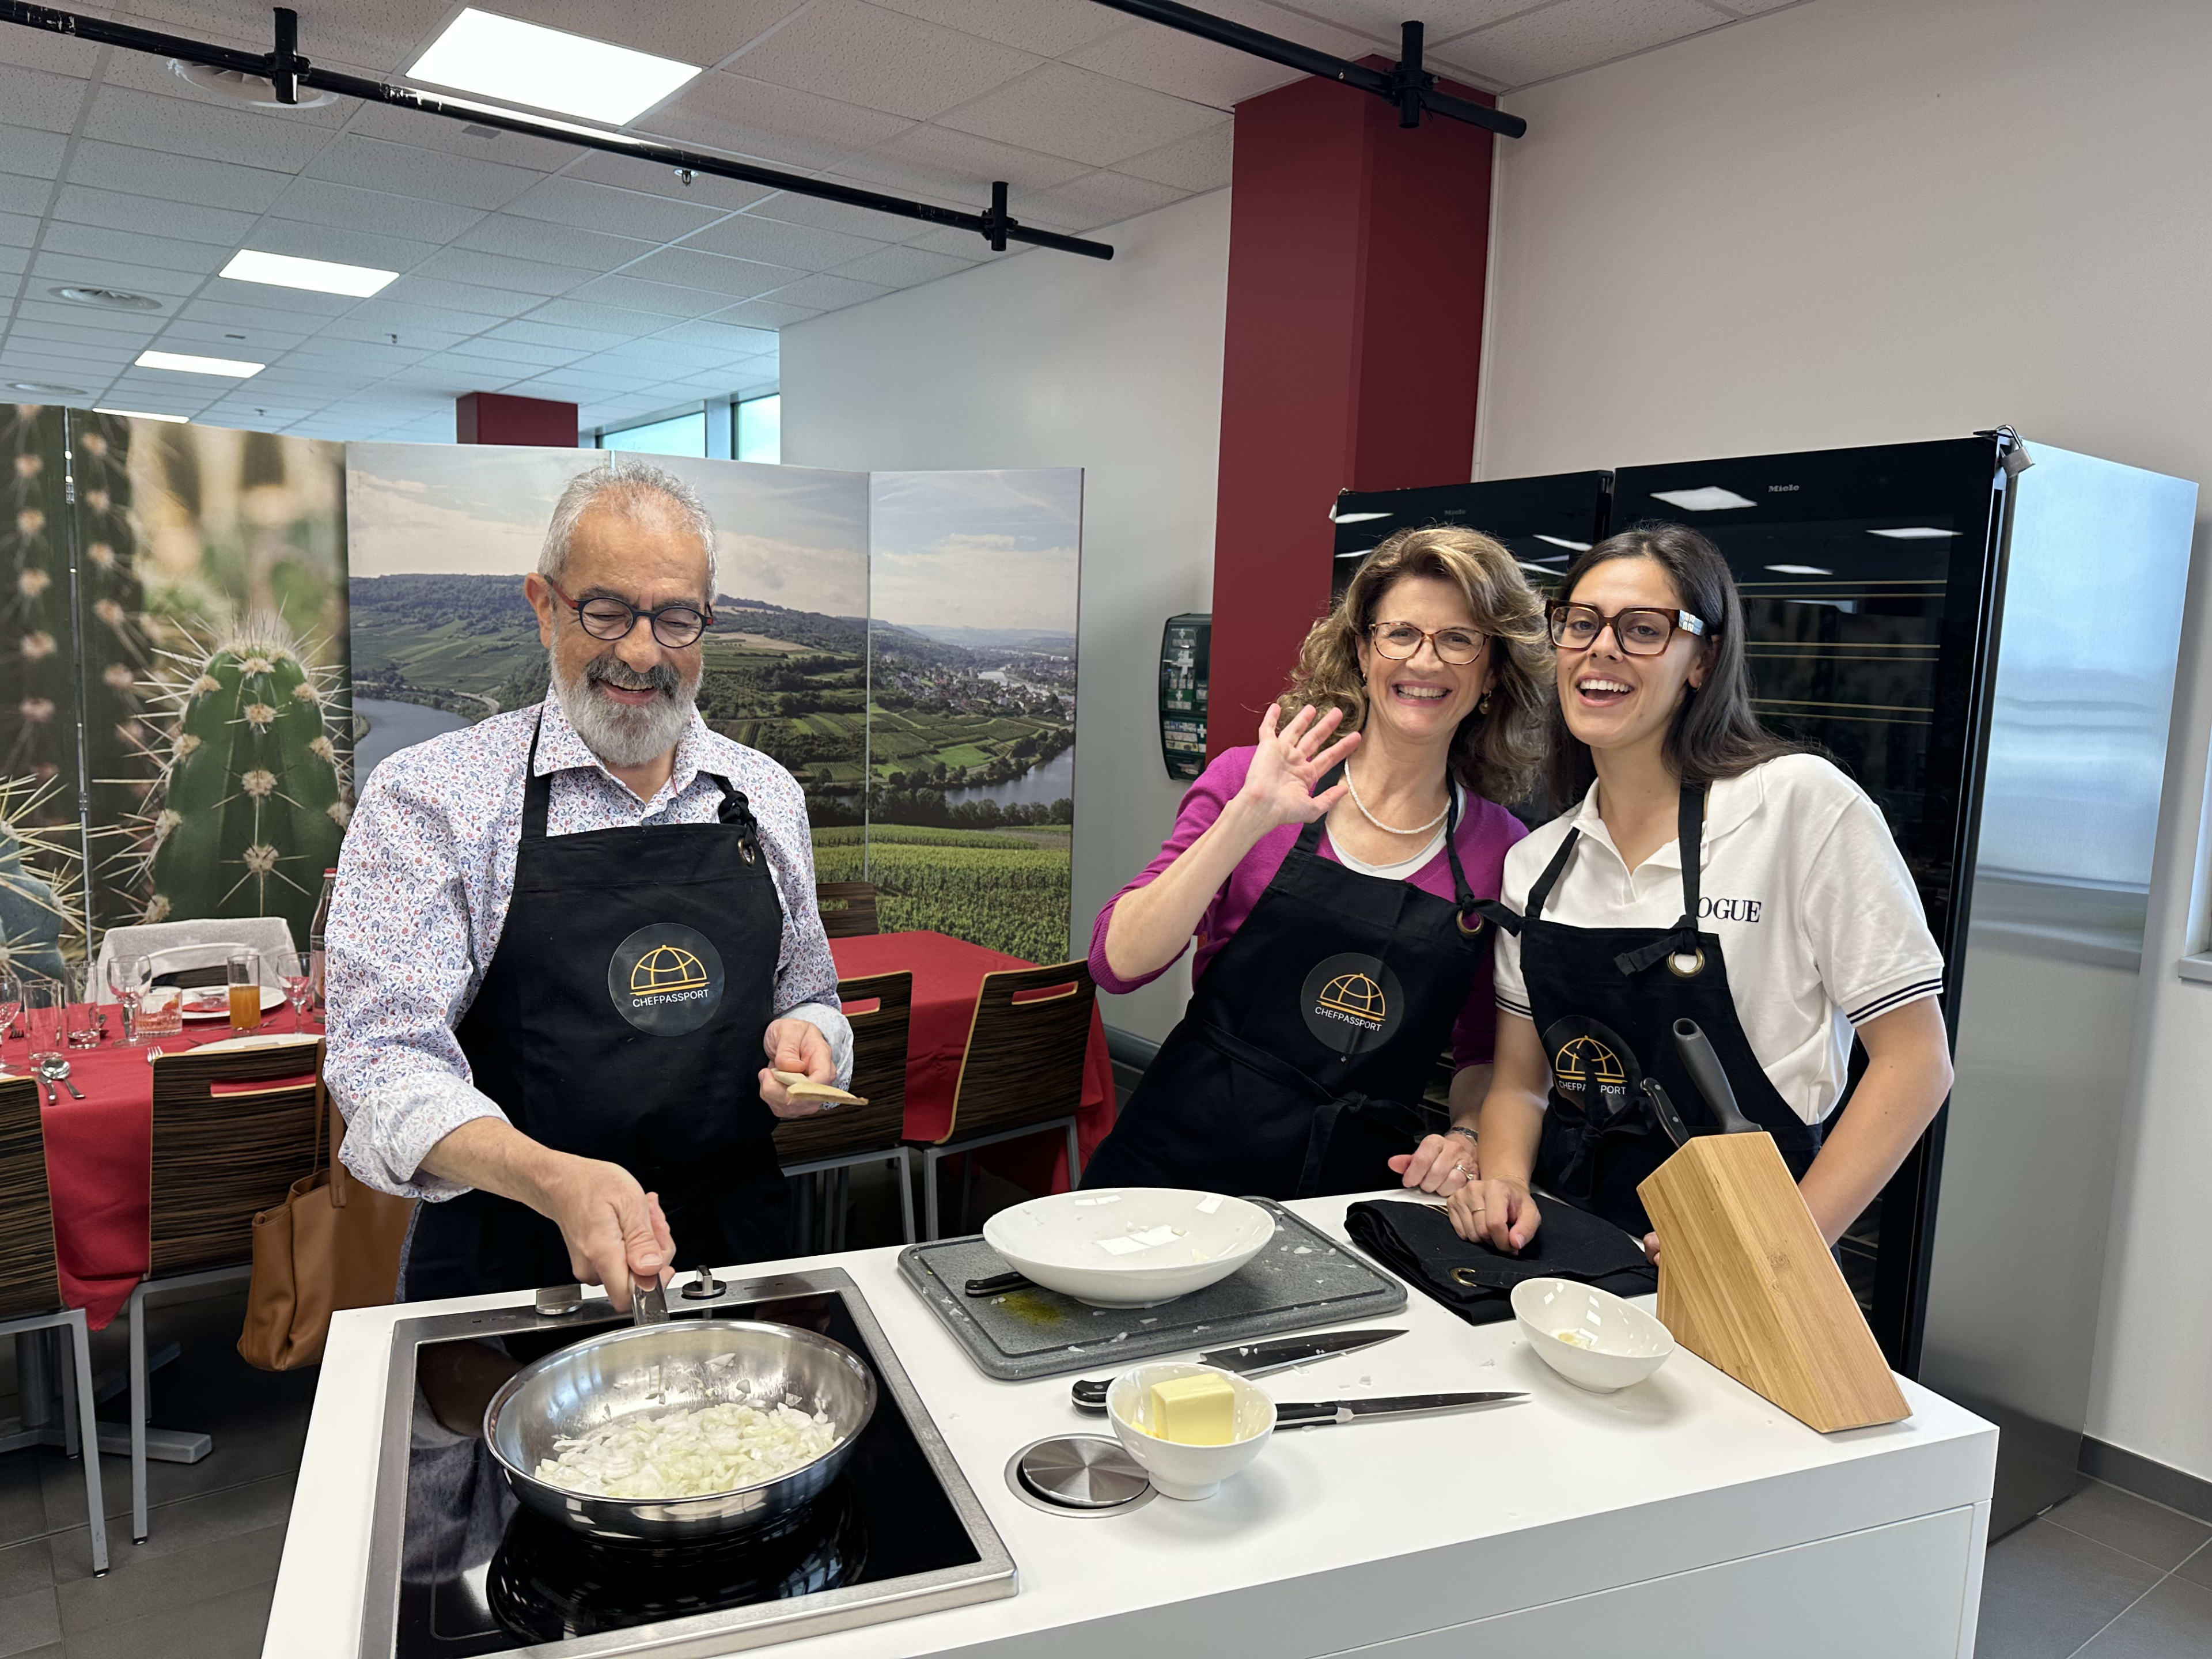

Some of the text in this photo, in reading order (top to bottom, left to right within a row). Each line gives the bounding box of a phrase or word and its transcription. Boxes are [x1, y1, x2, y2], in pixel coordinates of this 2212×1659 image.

[1768, 484, 1800, 493] Miele
[1698, 897, 1762, 923] OGUE
[632, 988, 709, 1007] CHEFPASSPORT
[1315, 1006, 1382, 1032] CHEFPASSPORT
[1558, 1080, 1626, 1095] CHEFPAPORT
